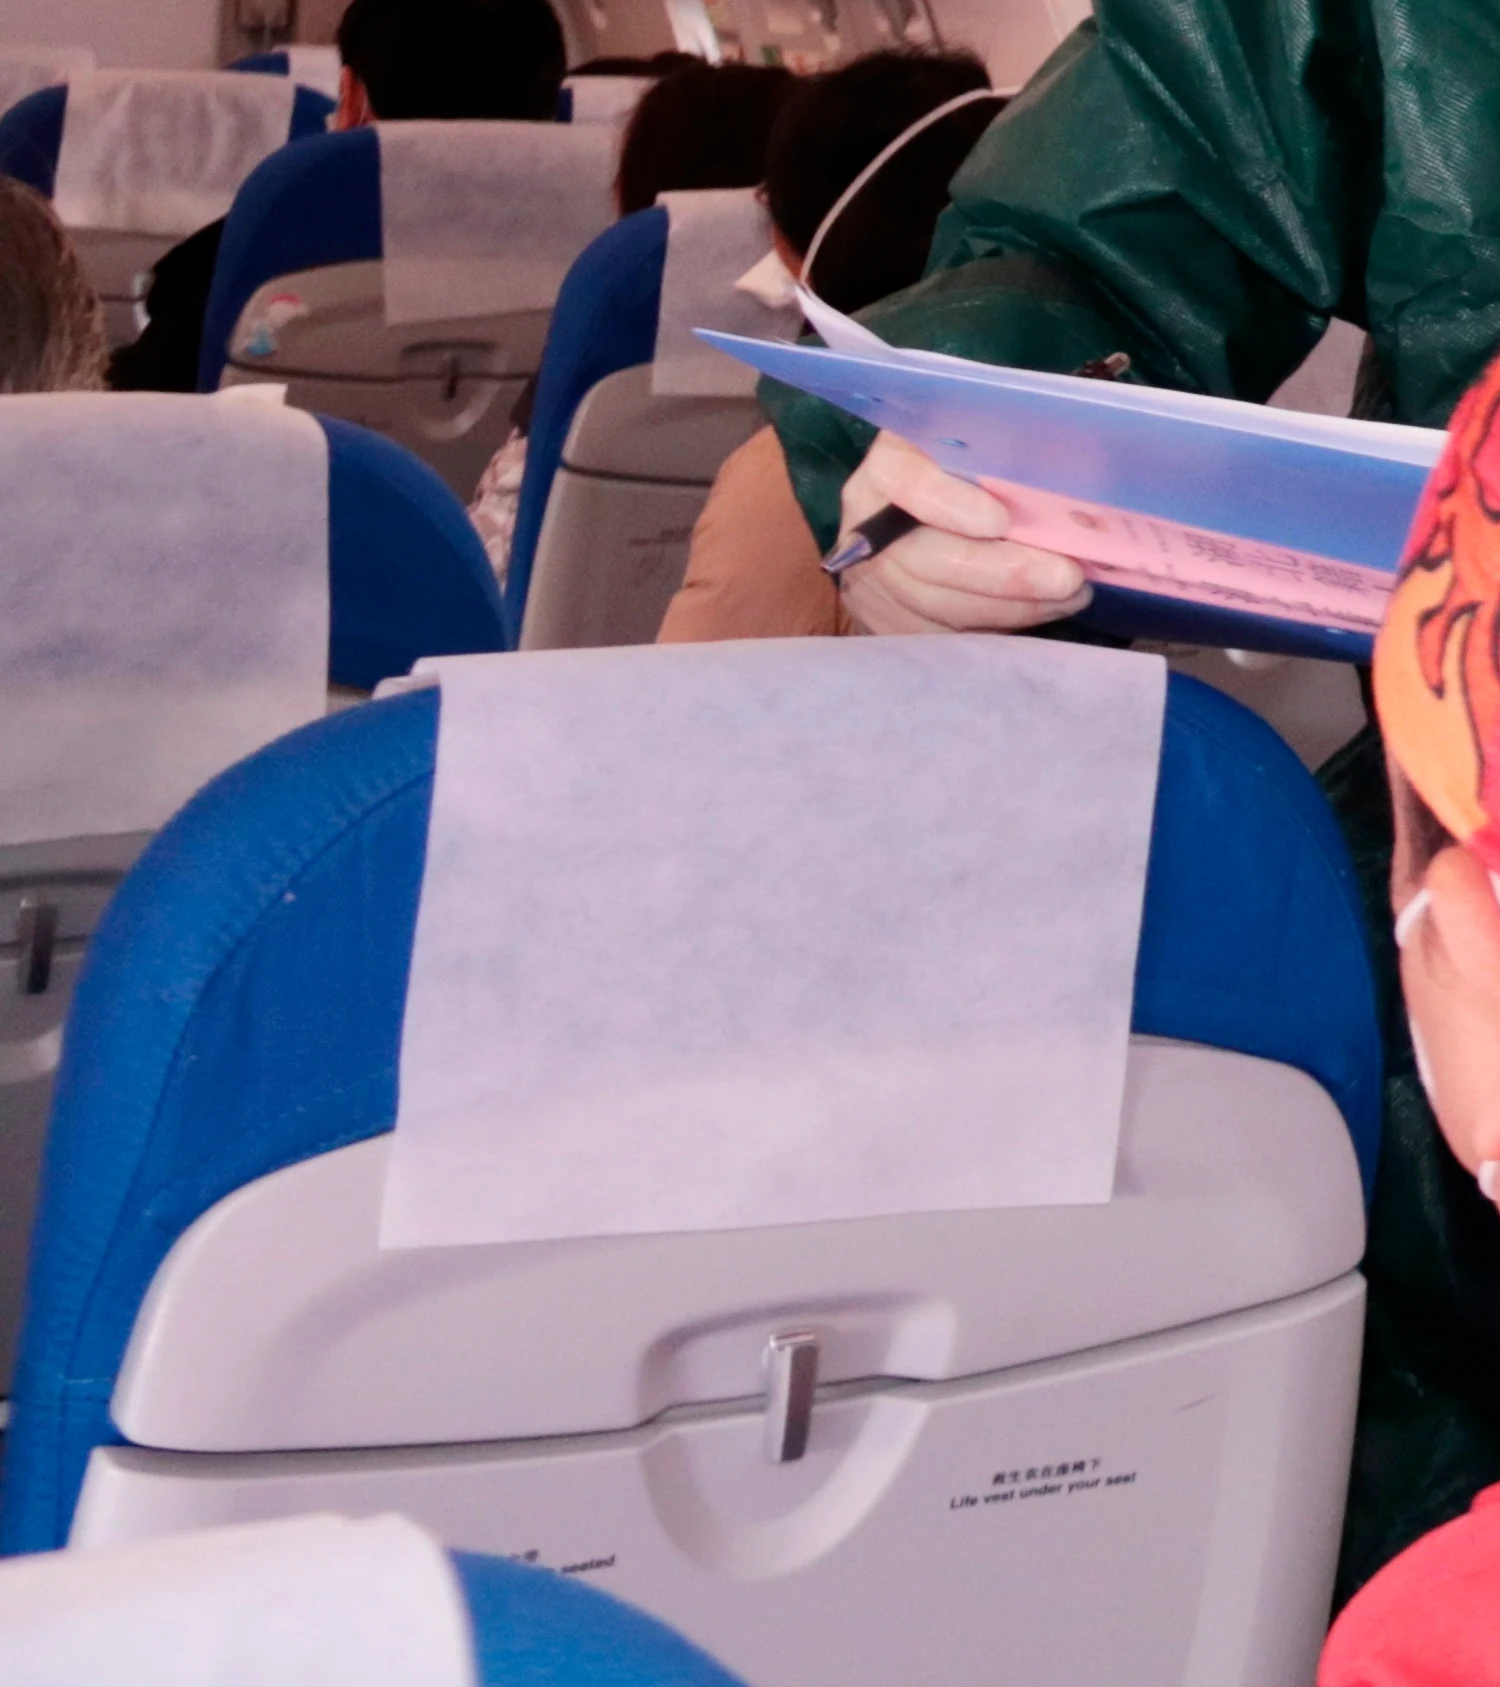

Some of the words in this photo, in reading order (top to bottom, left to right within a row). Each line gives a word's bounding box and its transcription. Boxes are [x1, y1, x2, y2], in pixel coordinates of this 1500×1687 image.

[949, 1495, 979, 1511] Life
[983, 1489, 1017, 1505] vest
[1019, 1483, 1064, 1499] under
[1067, 1477, 1101, 1495] your
[1105, 1470, 1137, 1487] seat
